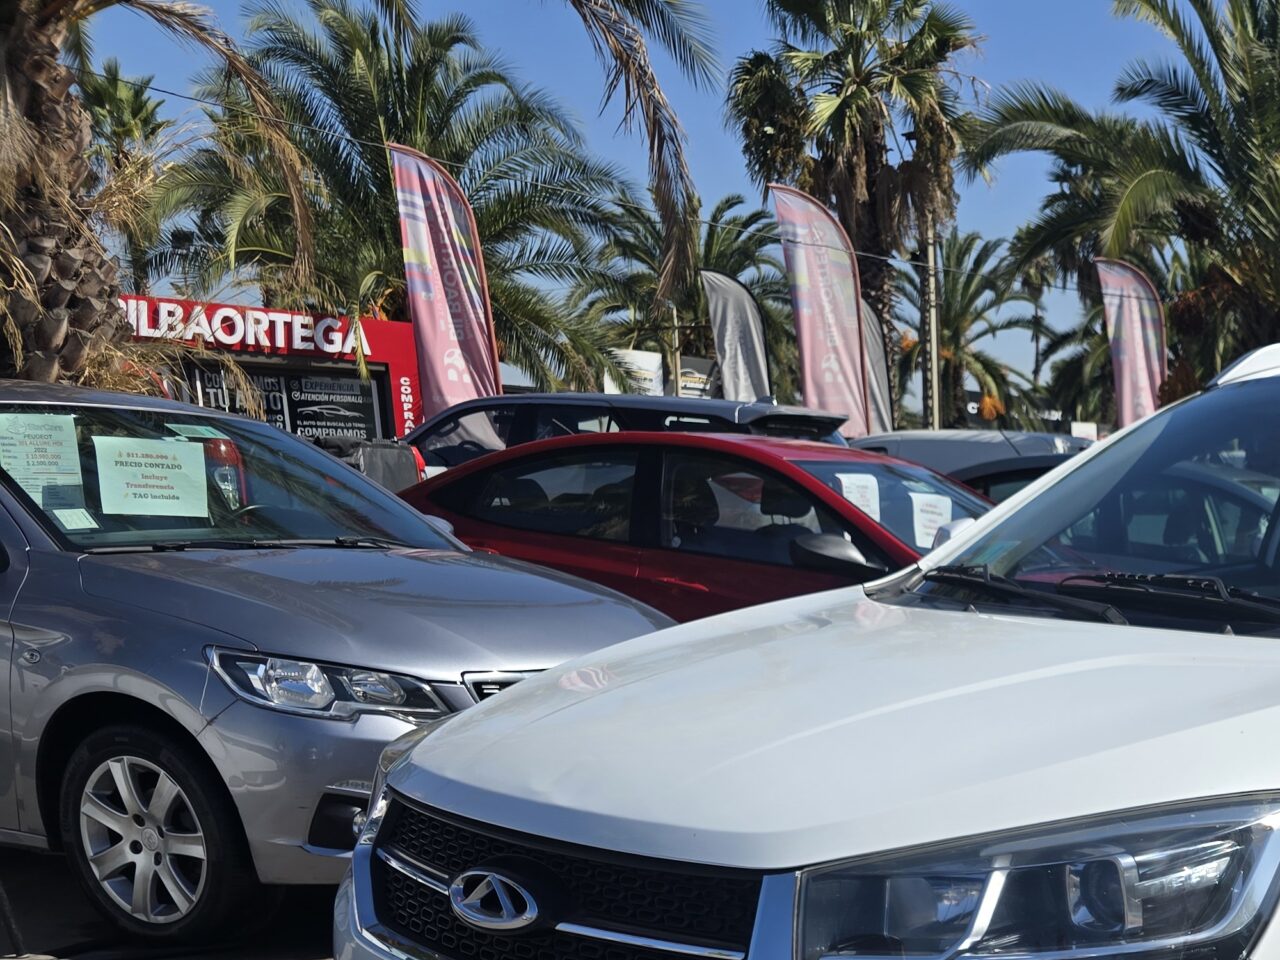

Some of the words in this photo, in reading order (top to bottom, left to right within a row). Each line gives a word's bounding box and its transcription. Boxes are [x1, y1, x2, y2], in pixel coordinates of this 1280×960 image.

[304, 380, 355, 392] EXPERIENCIA
[205, 388, 230, 408] TU
[235, 389, 282, 411] ATO
[300, 391, 329, 402] ATENCIÓN
[297, 427, 367, 439] COMPRAMOS
[114, 460, 143, 468] PRECIO
[125, 482, 175, 490] Transferencia
